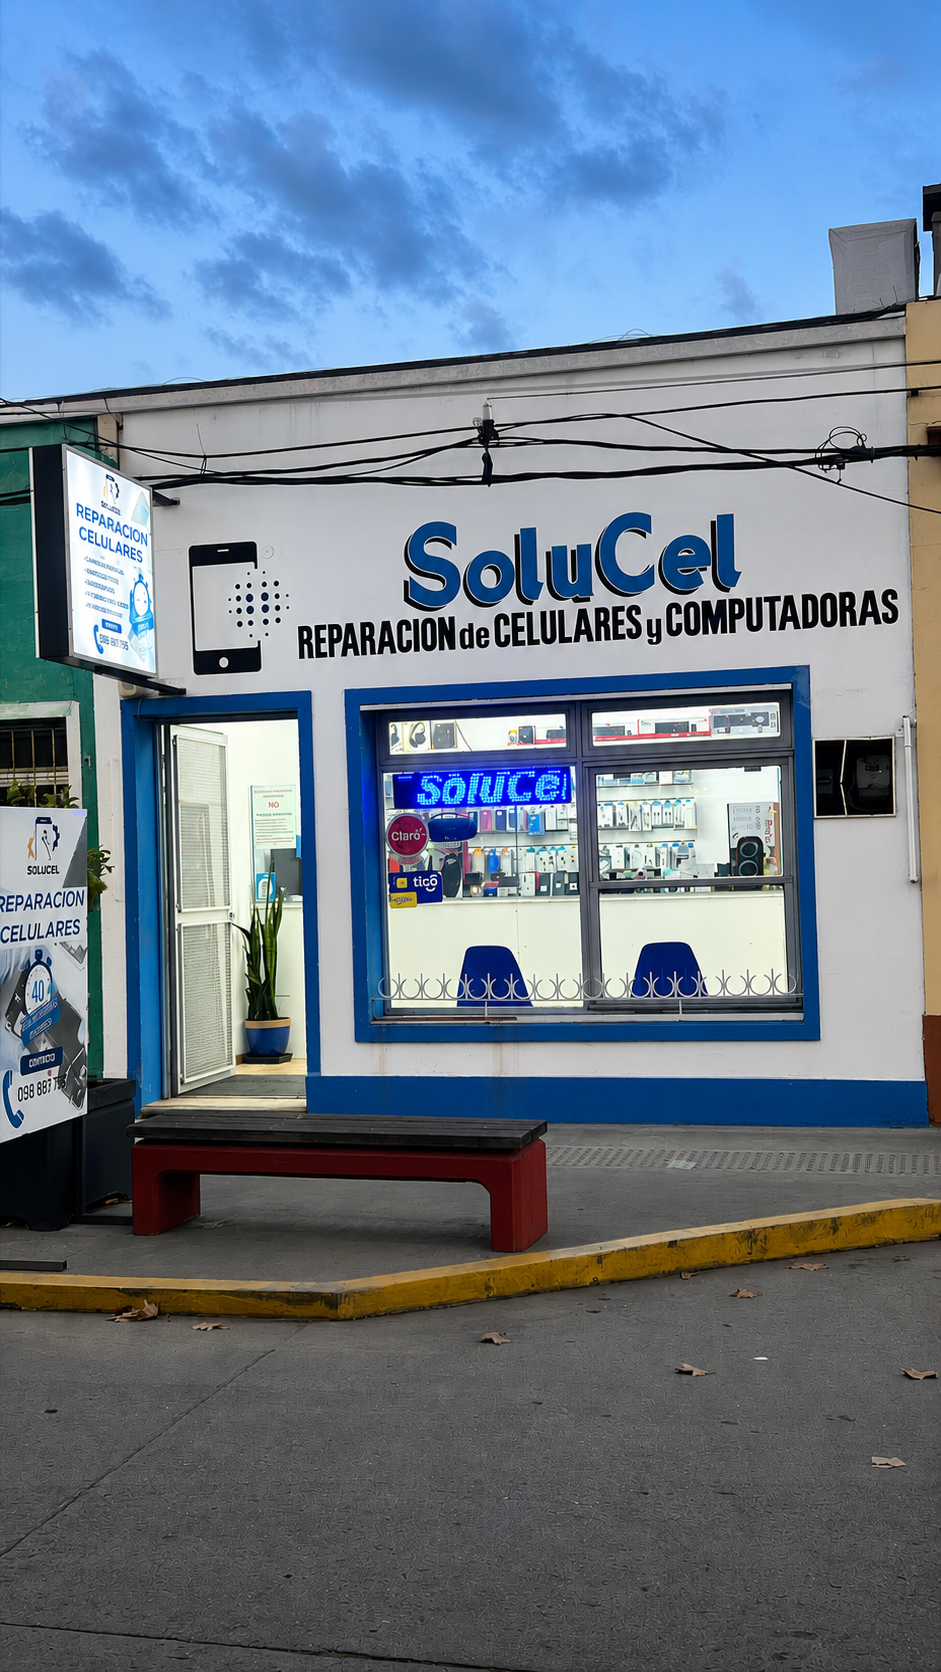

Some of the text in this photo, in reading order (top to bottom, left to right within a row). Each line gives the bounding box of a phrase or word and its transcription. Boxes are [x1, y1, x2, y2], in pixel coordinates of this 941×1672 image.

[76, 502, 148, 547] REPARACION
[79, 526, 143, 563] CELULARES
[403, 512, 742, 612] SoluCel
[298, 588, 899, 659] REPARACION de CELULARES y COMPUTADORAS
[268, 801, 279, 809] NO
[391, 829, 421, 842] Claro
[27, 865, 60, 875] SOLUCEL
[0, 890, 85, 913] REPARACION
[0, 919, 80, 943] CELULARES
[32, 979, 44, 1003] 40
[18, 1083, 34, 1102] 098
[37, 1078, 51, 1096] 887
